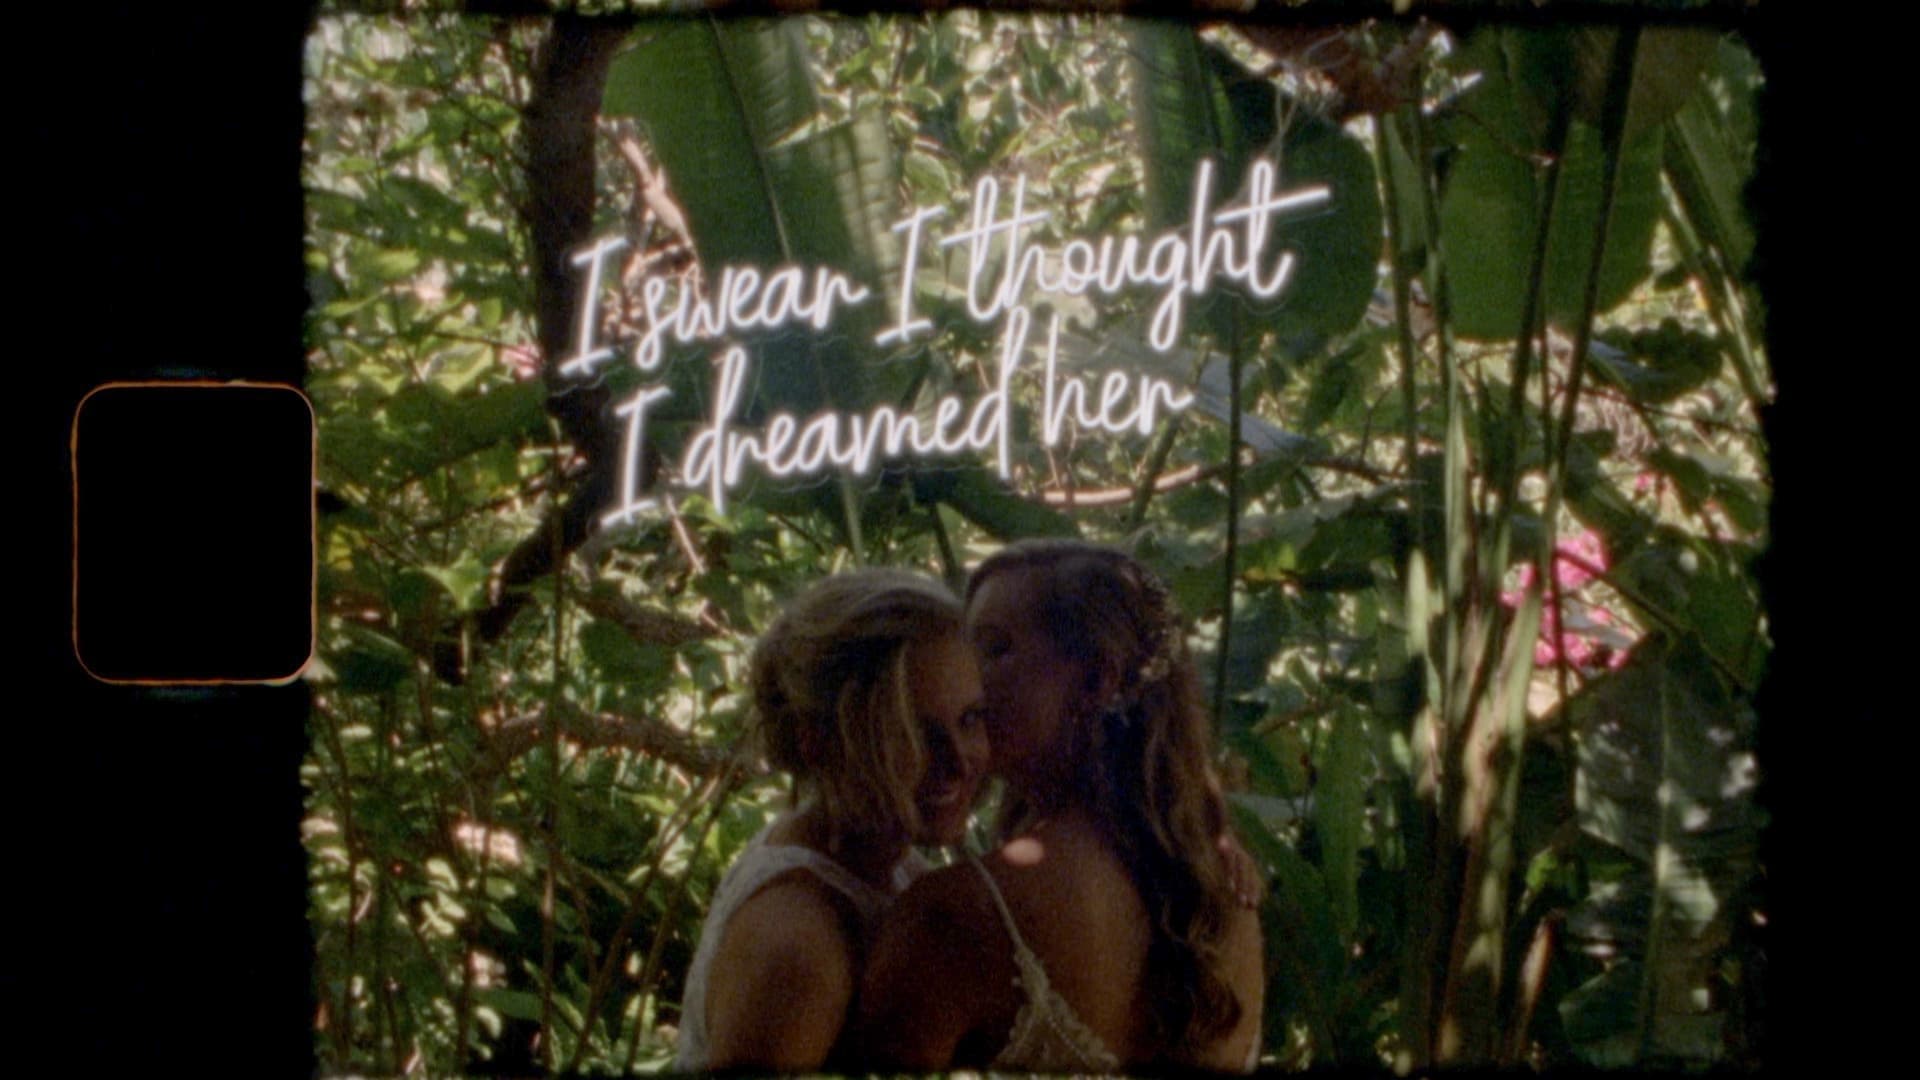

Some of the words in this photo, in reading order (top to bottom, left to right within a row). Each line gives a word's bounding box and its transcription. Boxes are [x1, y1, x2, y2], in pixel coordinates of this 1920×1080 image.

[559, 236, 628, 376] I
[635, 265, 869, 370] swear
[875, 204, 947, 346] I
[938, 158, 1331, 352] thought
[601, 385, 671, 525] I
[682, 305, 1030, 515] dreamed
[1043, 313, 1194, 446] her
